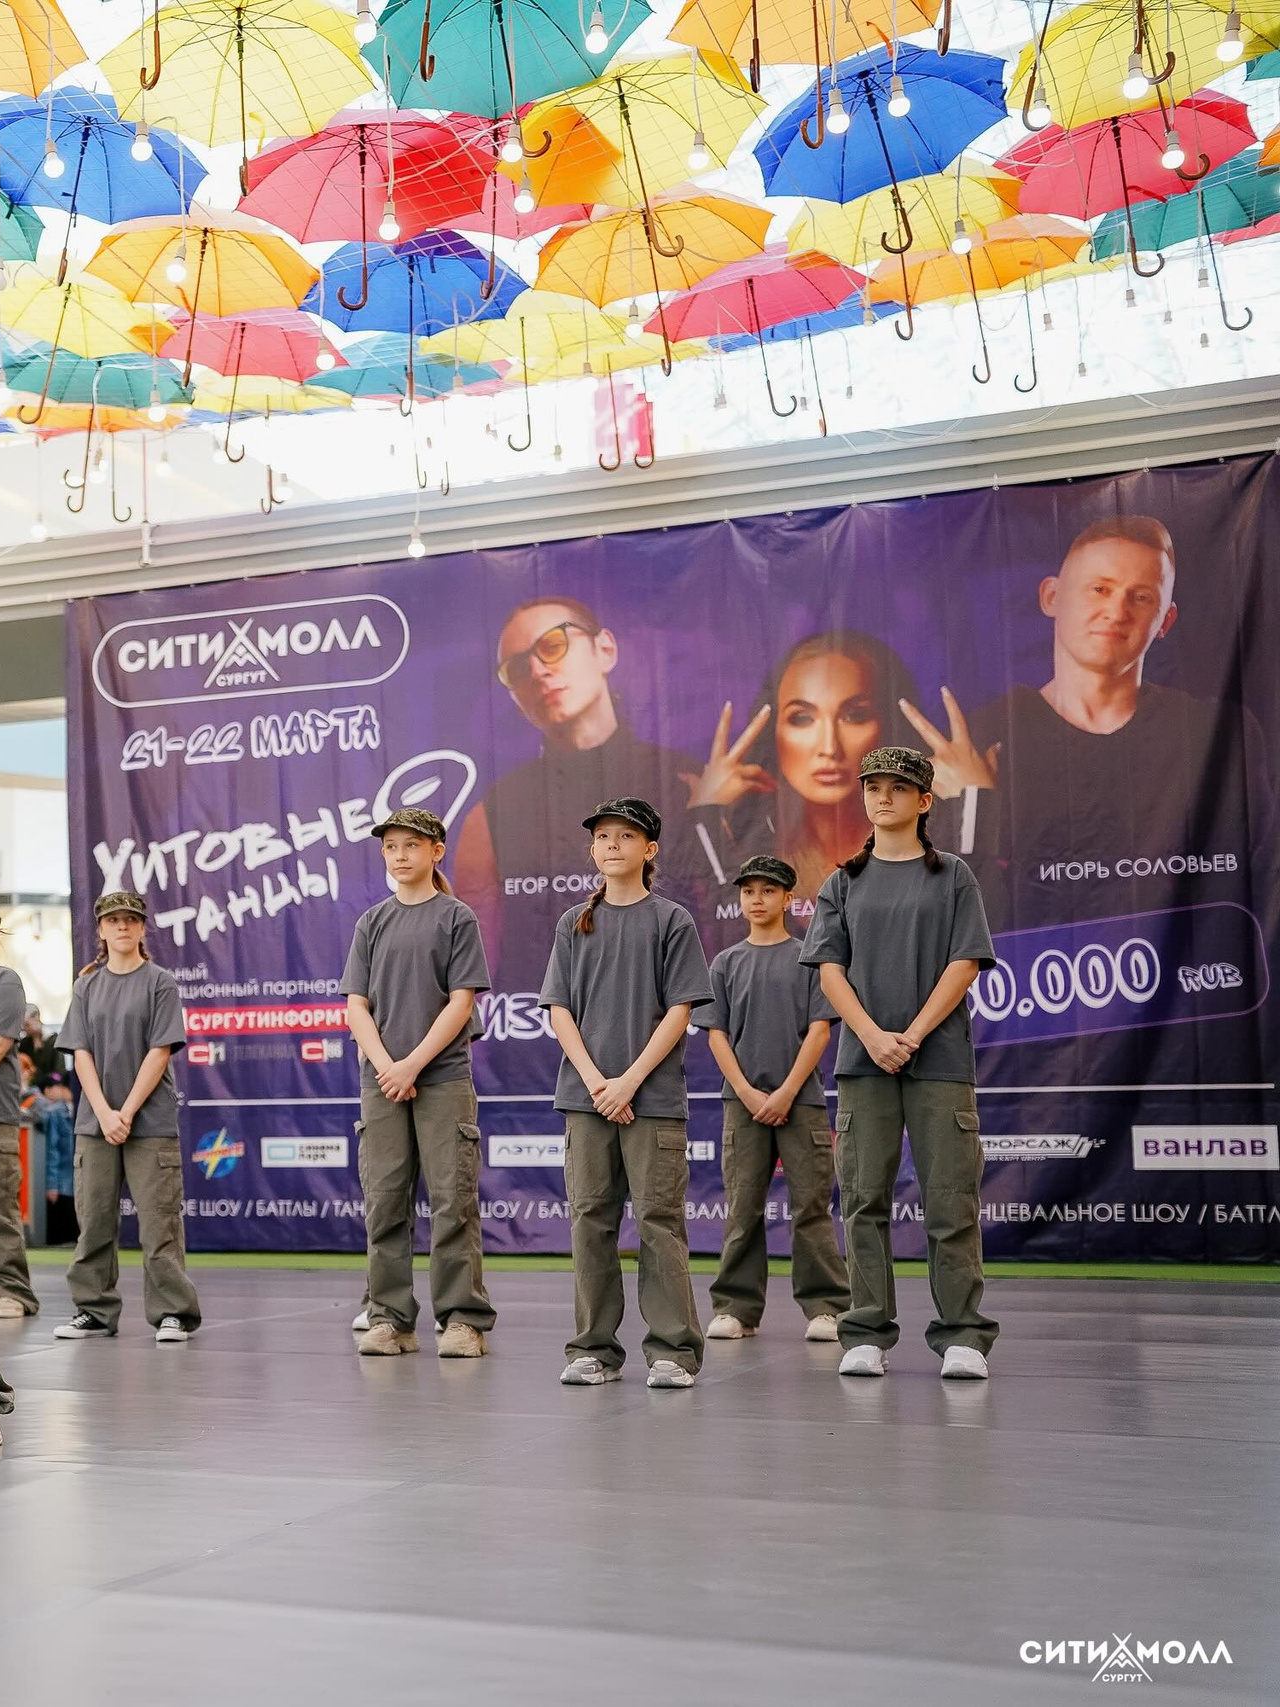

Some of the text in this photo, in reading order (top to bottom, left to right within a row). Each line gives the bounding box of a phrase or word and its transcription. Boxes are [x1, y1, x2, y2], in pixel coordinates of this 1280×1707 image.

[118, 614, 381, 673] СИТИ МОЛЛ
[215, 668, 270, 688] СУРГУТ
[120, 703, 381, 772] 21-22 МАРТА
[93, 797, 376, 894] ХИТОВЫЕ
[1039, 852, 1239, 881] ИГОРЬ СОЛОВЬЕВ
[504, 872, 605, 895] ЕГОР СОКО
[154, 856, 339, 946] ТАНЦЫ
[967, 936, 1243, 1024] 0.000 RUB
[188, 1008, 348, 1032] СУРГУТИНФОРМТ
[1143, 1136, 1269, 1158] ванлав
[199, 1199, 242, 1218] ШОУ
[256, 1199, 317, 1217] БАТТЛЫ
[980, 1202, 1126, 1223] НЦЕВАЛЬНОЕ
[1132, 1203, 1191, 1224] ШОУ
[1213, 1203, 1280, 1224] БАТТЛ
